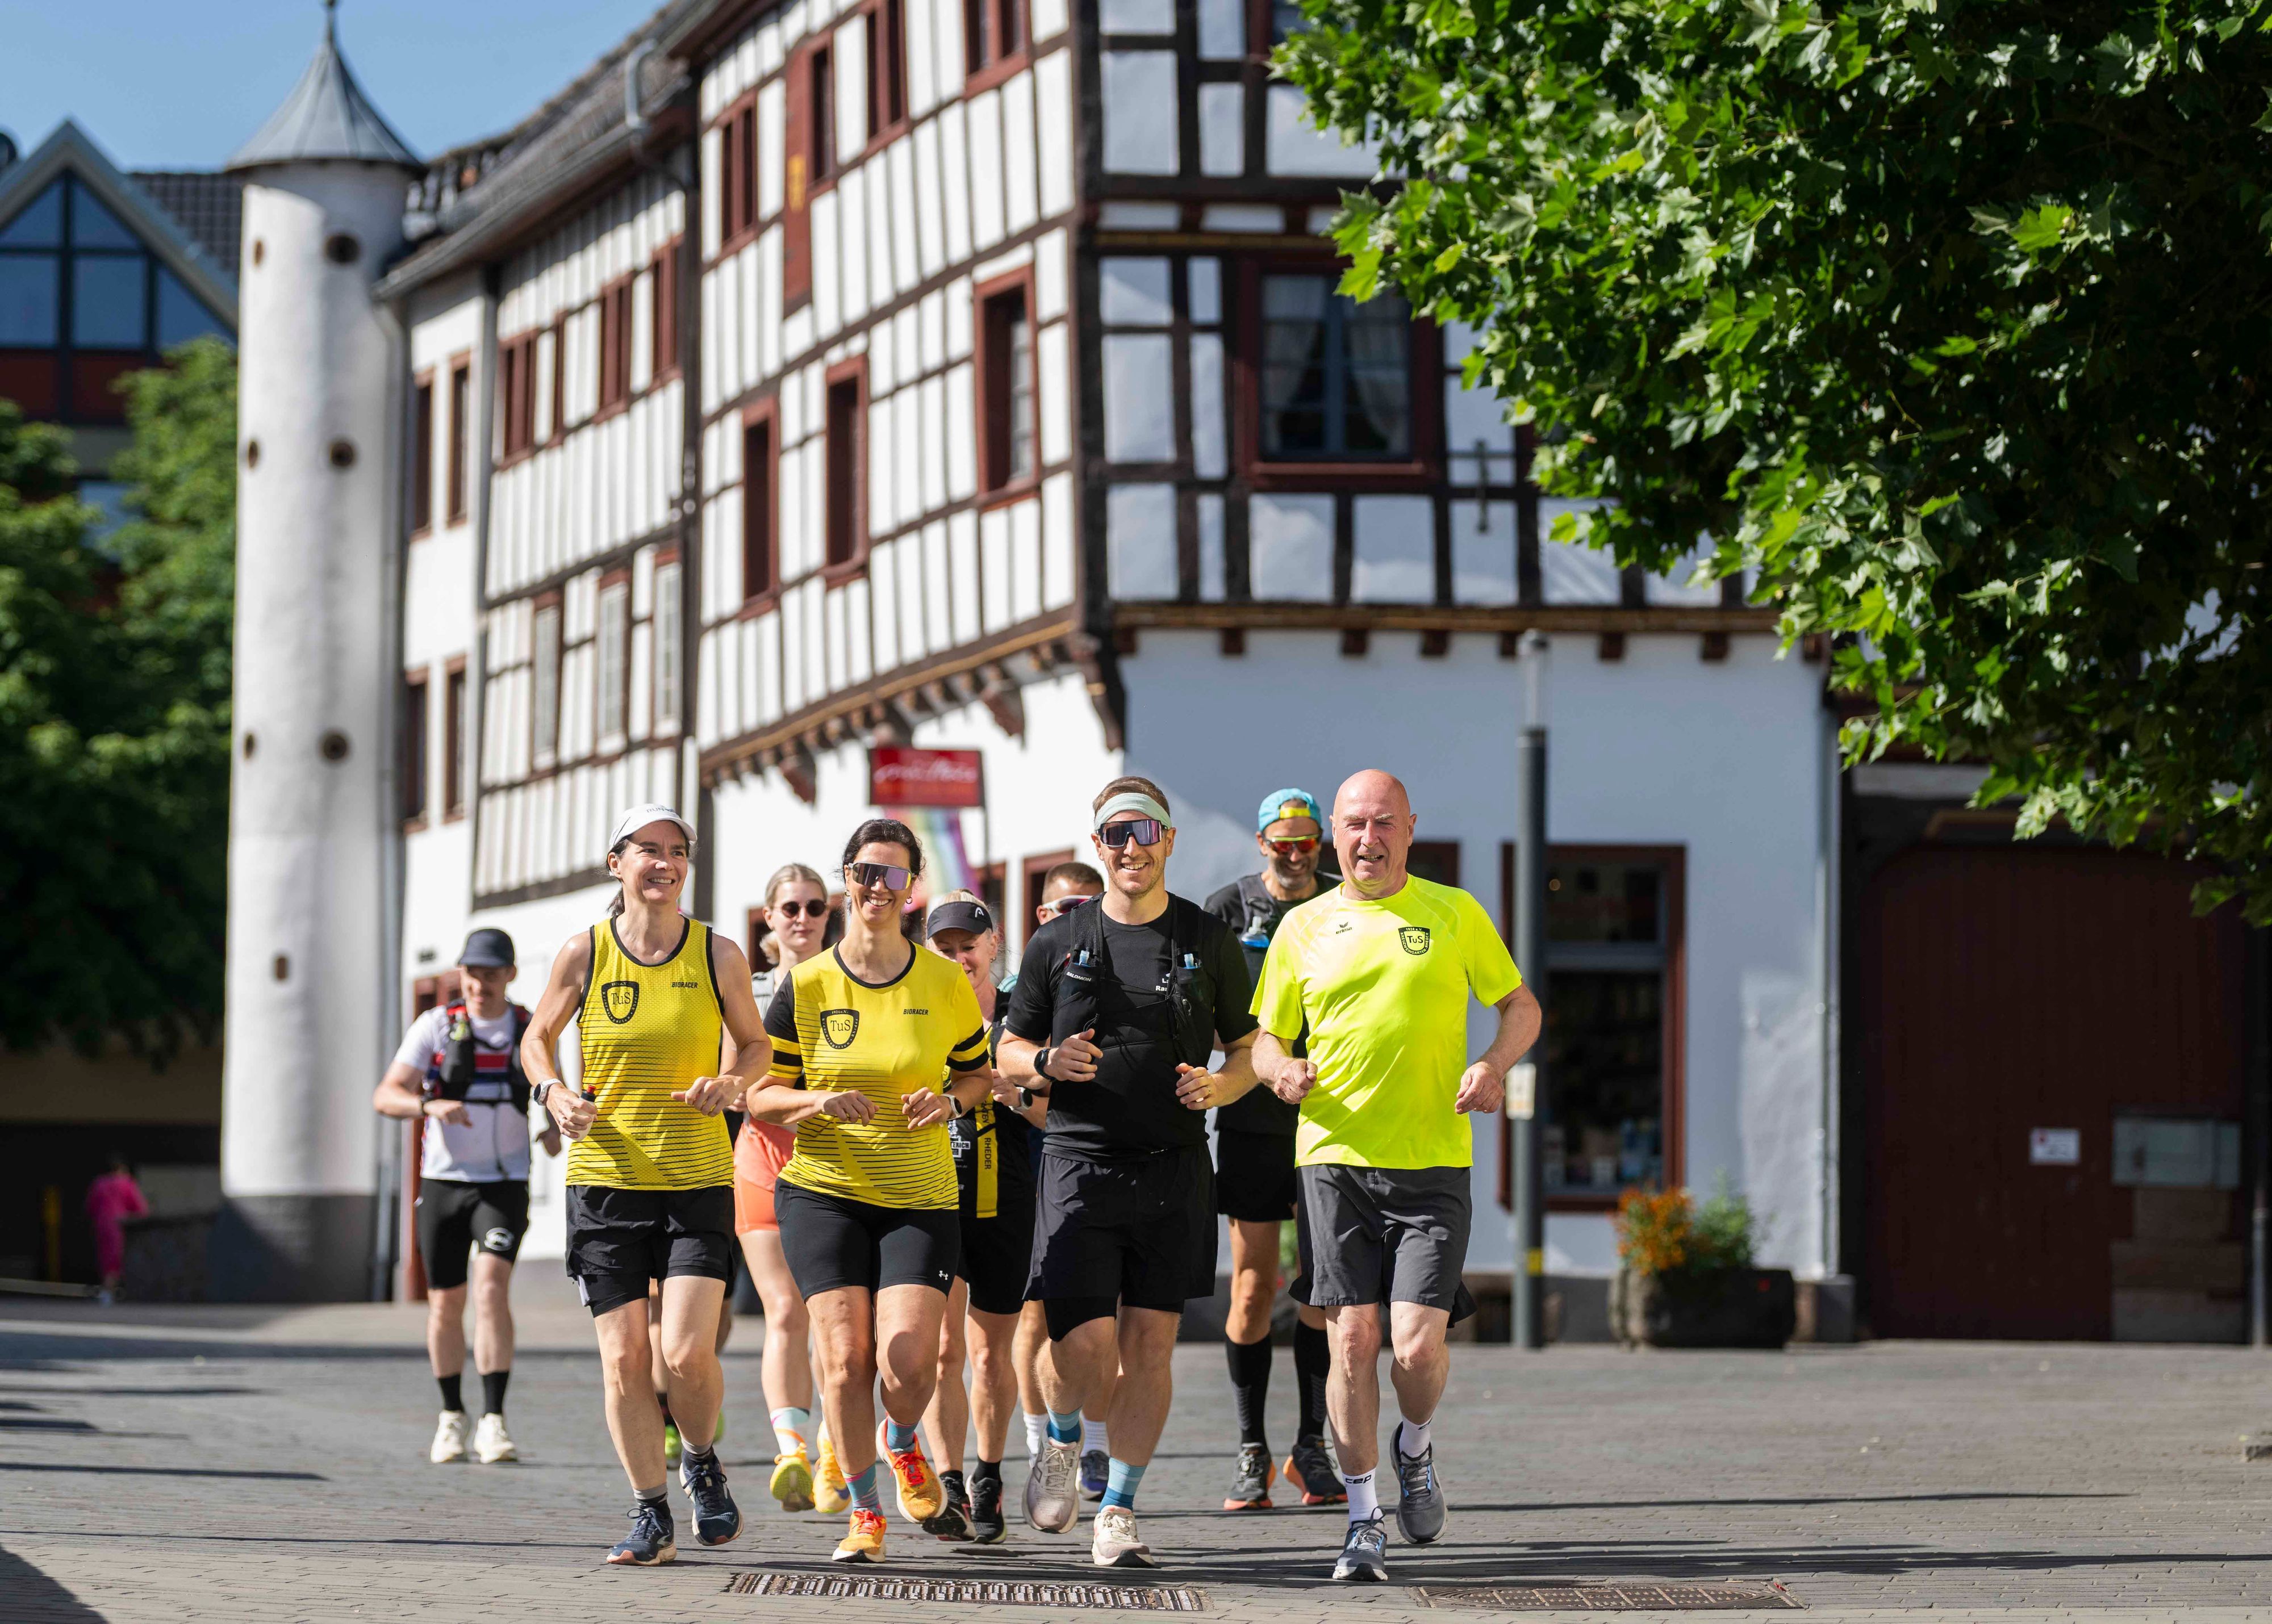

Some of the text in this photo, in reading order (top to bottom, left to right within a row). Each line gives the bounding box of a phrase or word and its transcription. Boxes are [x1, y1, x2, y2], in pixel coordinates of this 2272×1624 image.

[1406, 935, 1423, 944] TuS
[1066, 971, 1092, 982] SALOMON
[611, 992, 631, 1005] TuS
[830, 1019, 851, 1031] TuS
[1345, 1474, 1372, 1484] cep
